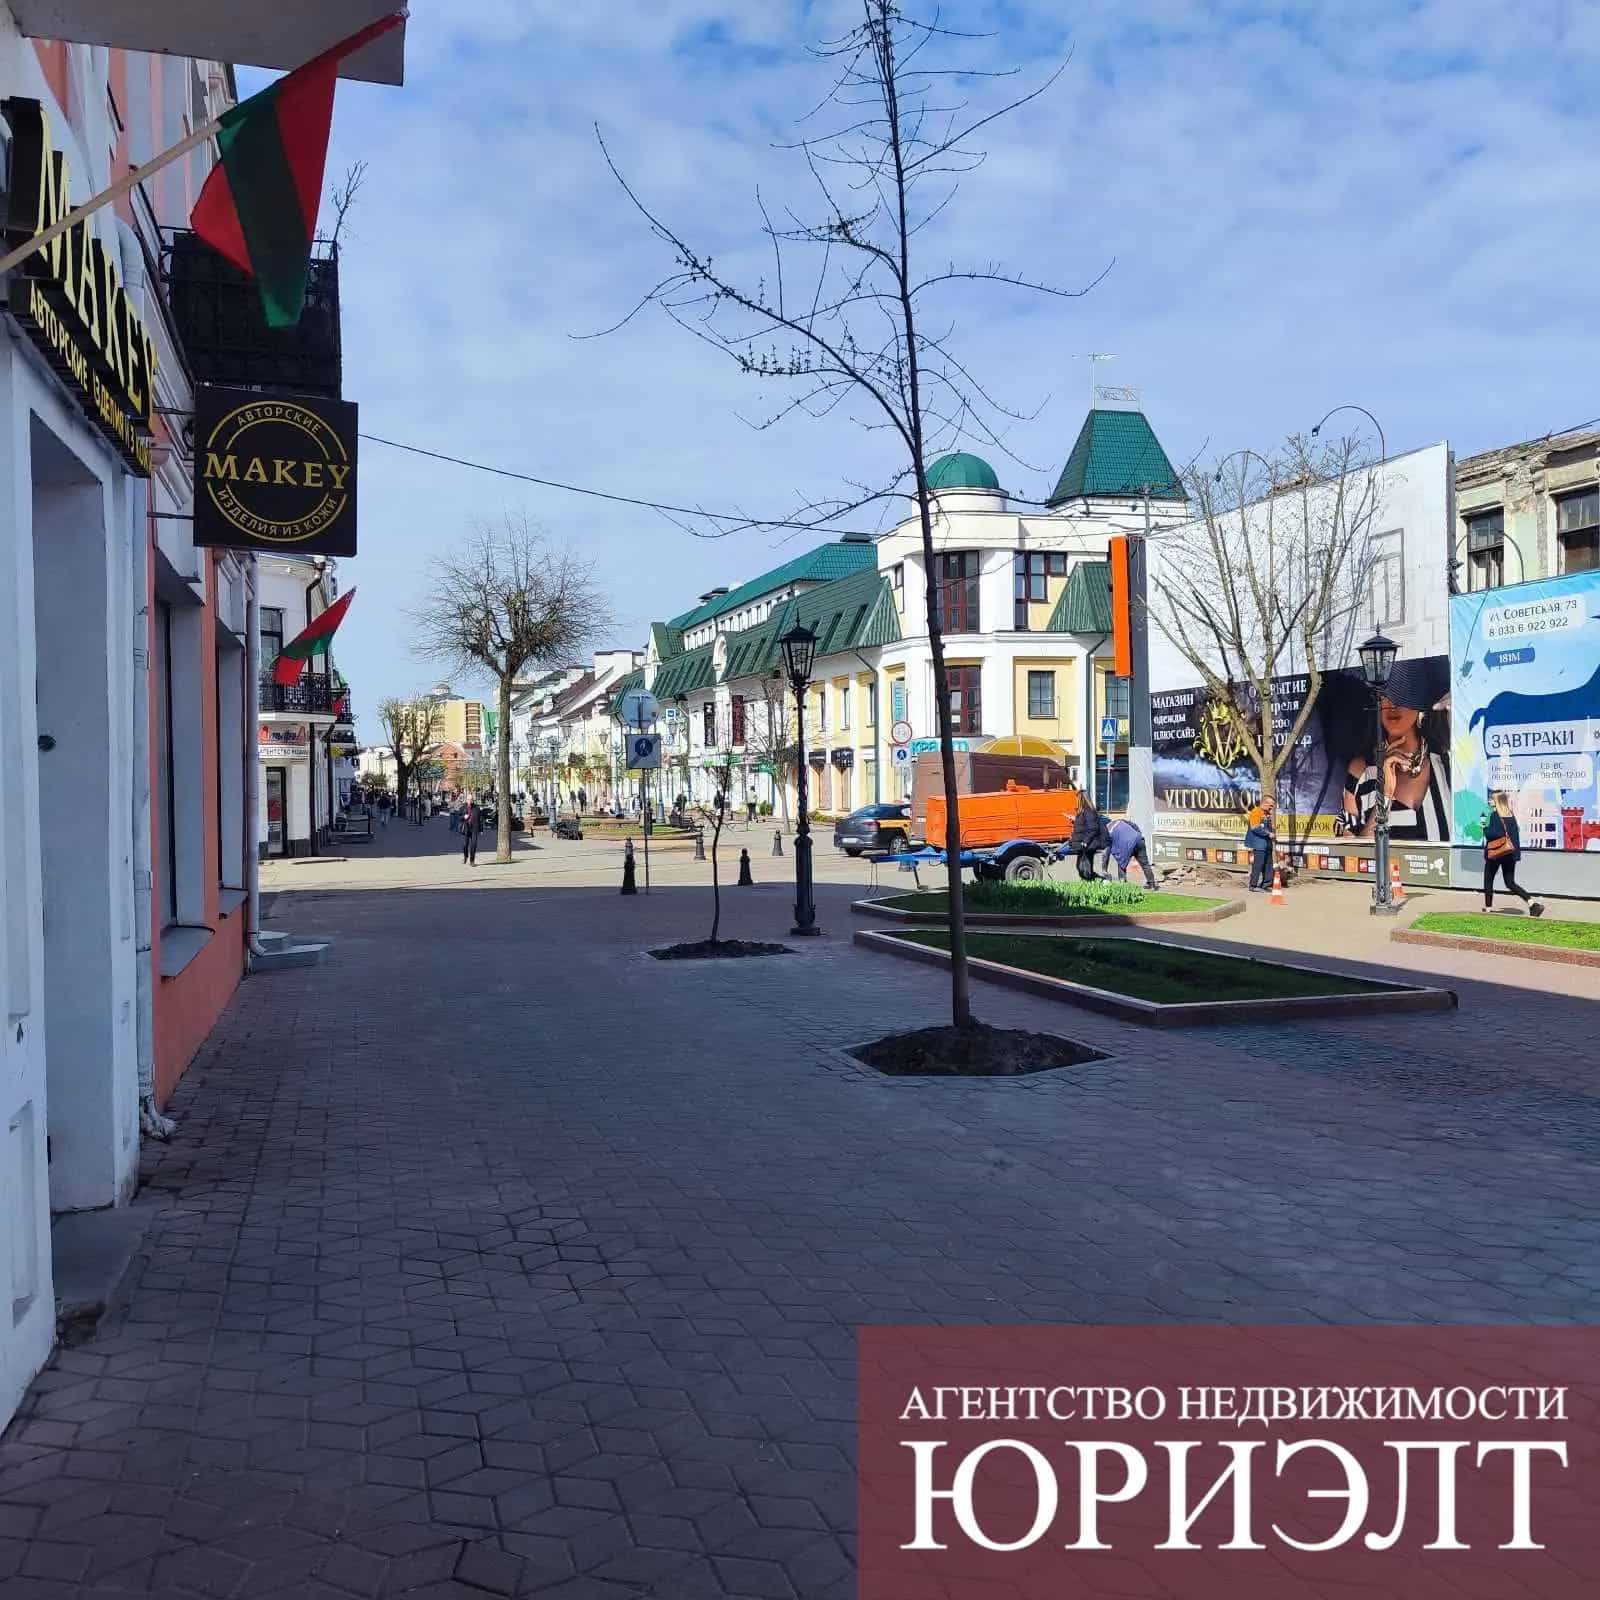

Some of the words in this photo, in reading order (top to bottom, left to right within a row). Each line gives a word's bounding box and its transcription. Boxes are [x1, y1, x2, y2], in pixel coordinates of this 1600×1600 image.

[30, 279, 88, 394] АВТОРСКИЕ
[237, 406, 322, 434] АВТОРСКИЕ
[203, 453, 350, 489] MAKEY
[217, 488, 279, 535] ИЗДЕЛИЯ
[282, 526, 301, 536] ИЗ
[304, 498, 337, 531] КОЖИ
[1152, 694, 1194, 708] МАГАЗИН
[1248, 680, 1307, 698] ОРЫТИЕ
[1491, 730, 1575, 749] ЗАВТРАКИ
[1164, 788, 1237, 809] VITTORIA
